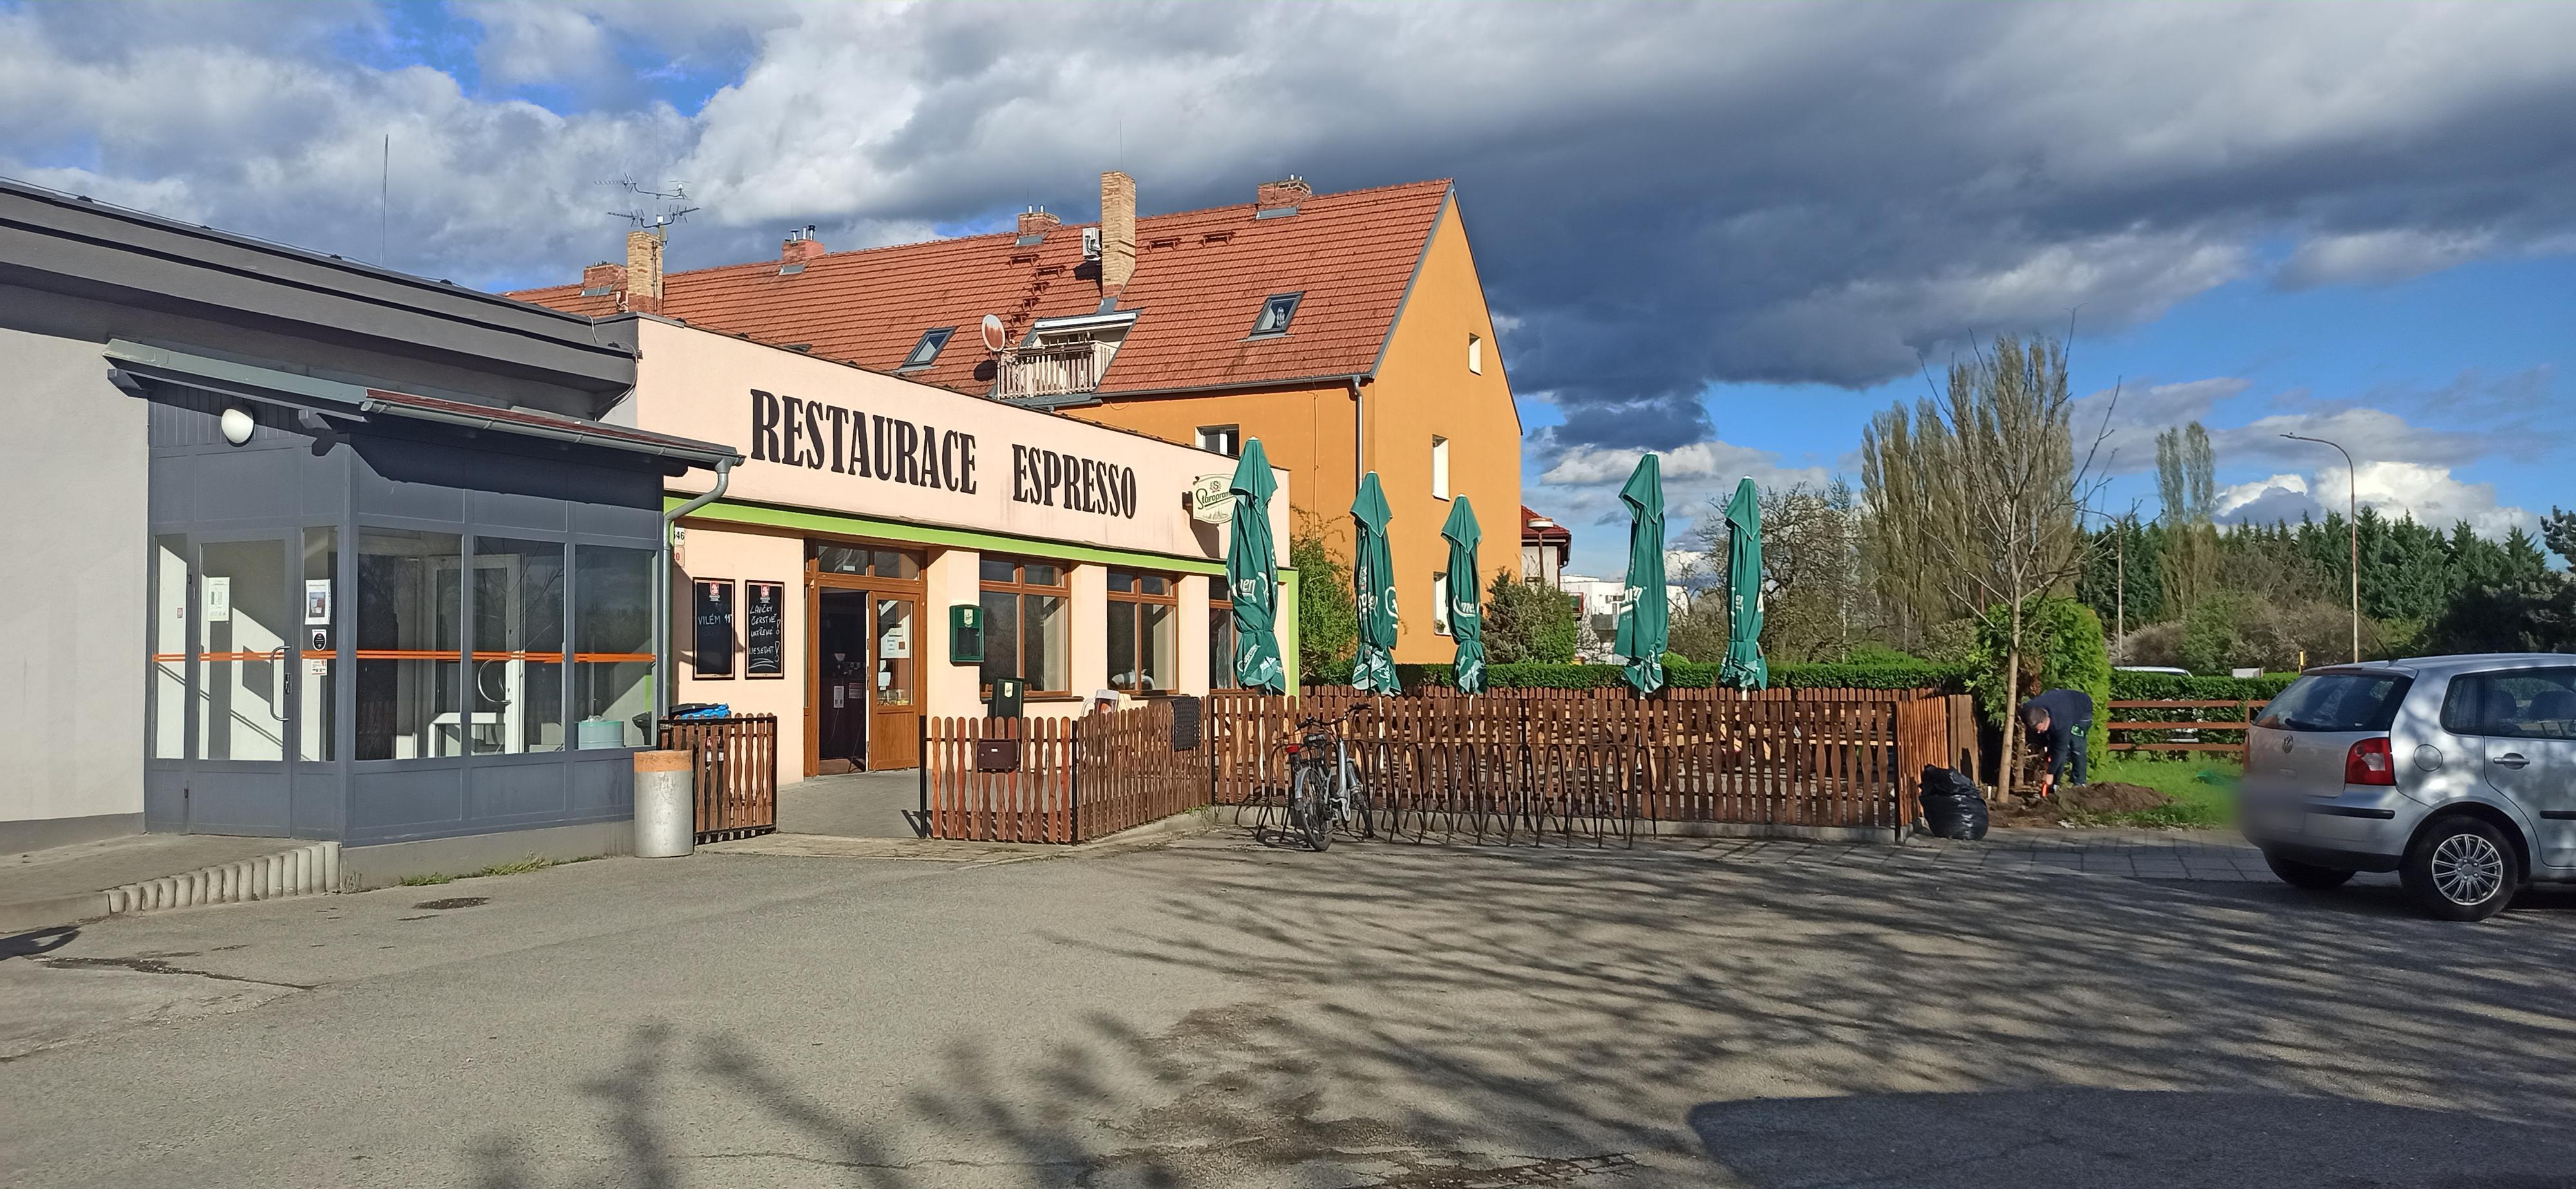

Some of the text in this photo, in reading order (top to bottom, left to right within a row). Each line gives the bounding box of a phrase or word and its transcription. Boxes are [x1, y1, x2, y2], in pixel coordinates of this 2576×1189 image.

[750, 389, 1137, 520] RESTAURACE ESPRESSO
[698, 613, 721, 625] VILÉM
